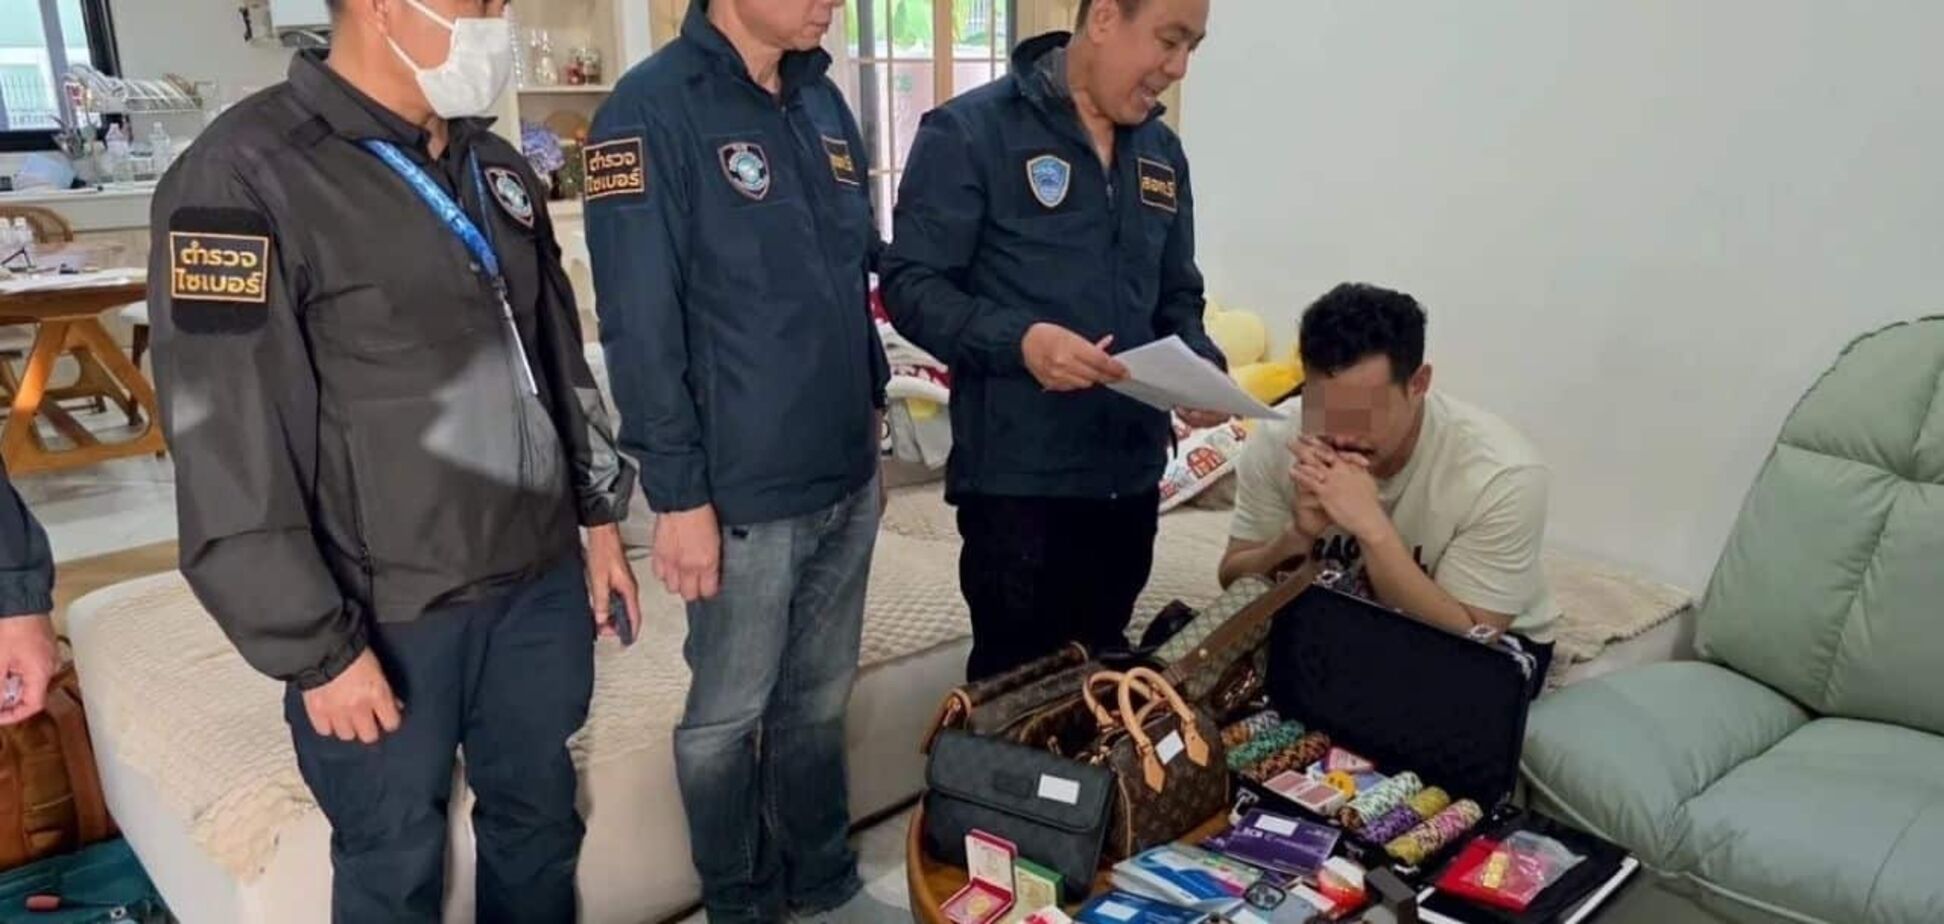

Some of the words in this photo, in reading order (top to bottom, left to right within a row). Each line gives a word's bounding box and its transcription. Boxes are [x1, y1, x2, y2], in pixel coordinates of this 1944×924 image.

[589, 150, 636, 171] ตำรวจ
[585, 168, 641, 192] ไซเบอร์
[181, 240, 258, 268] ตำรวจ
[175, 267, 262, 294] ไซเบอร์
